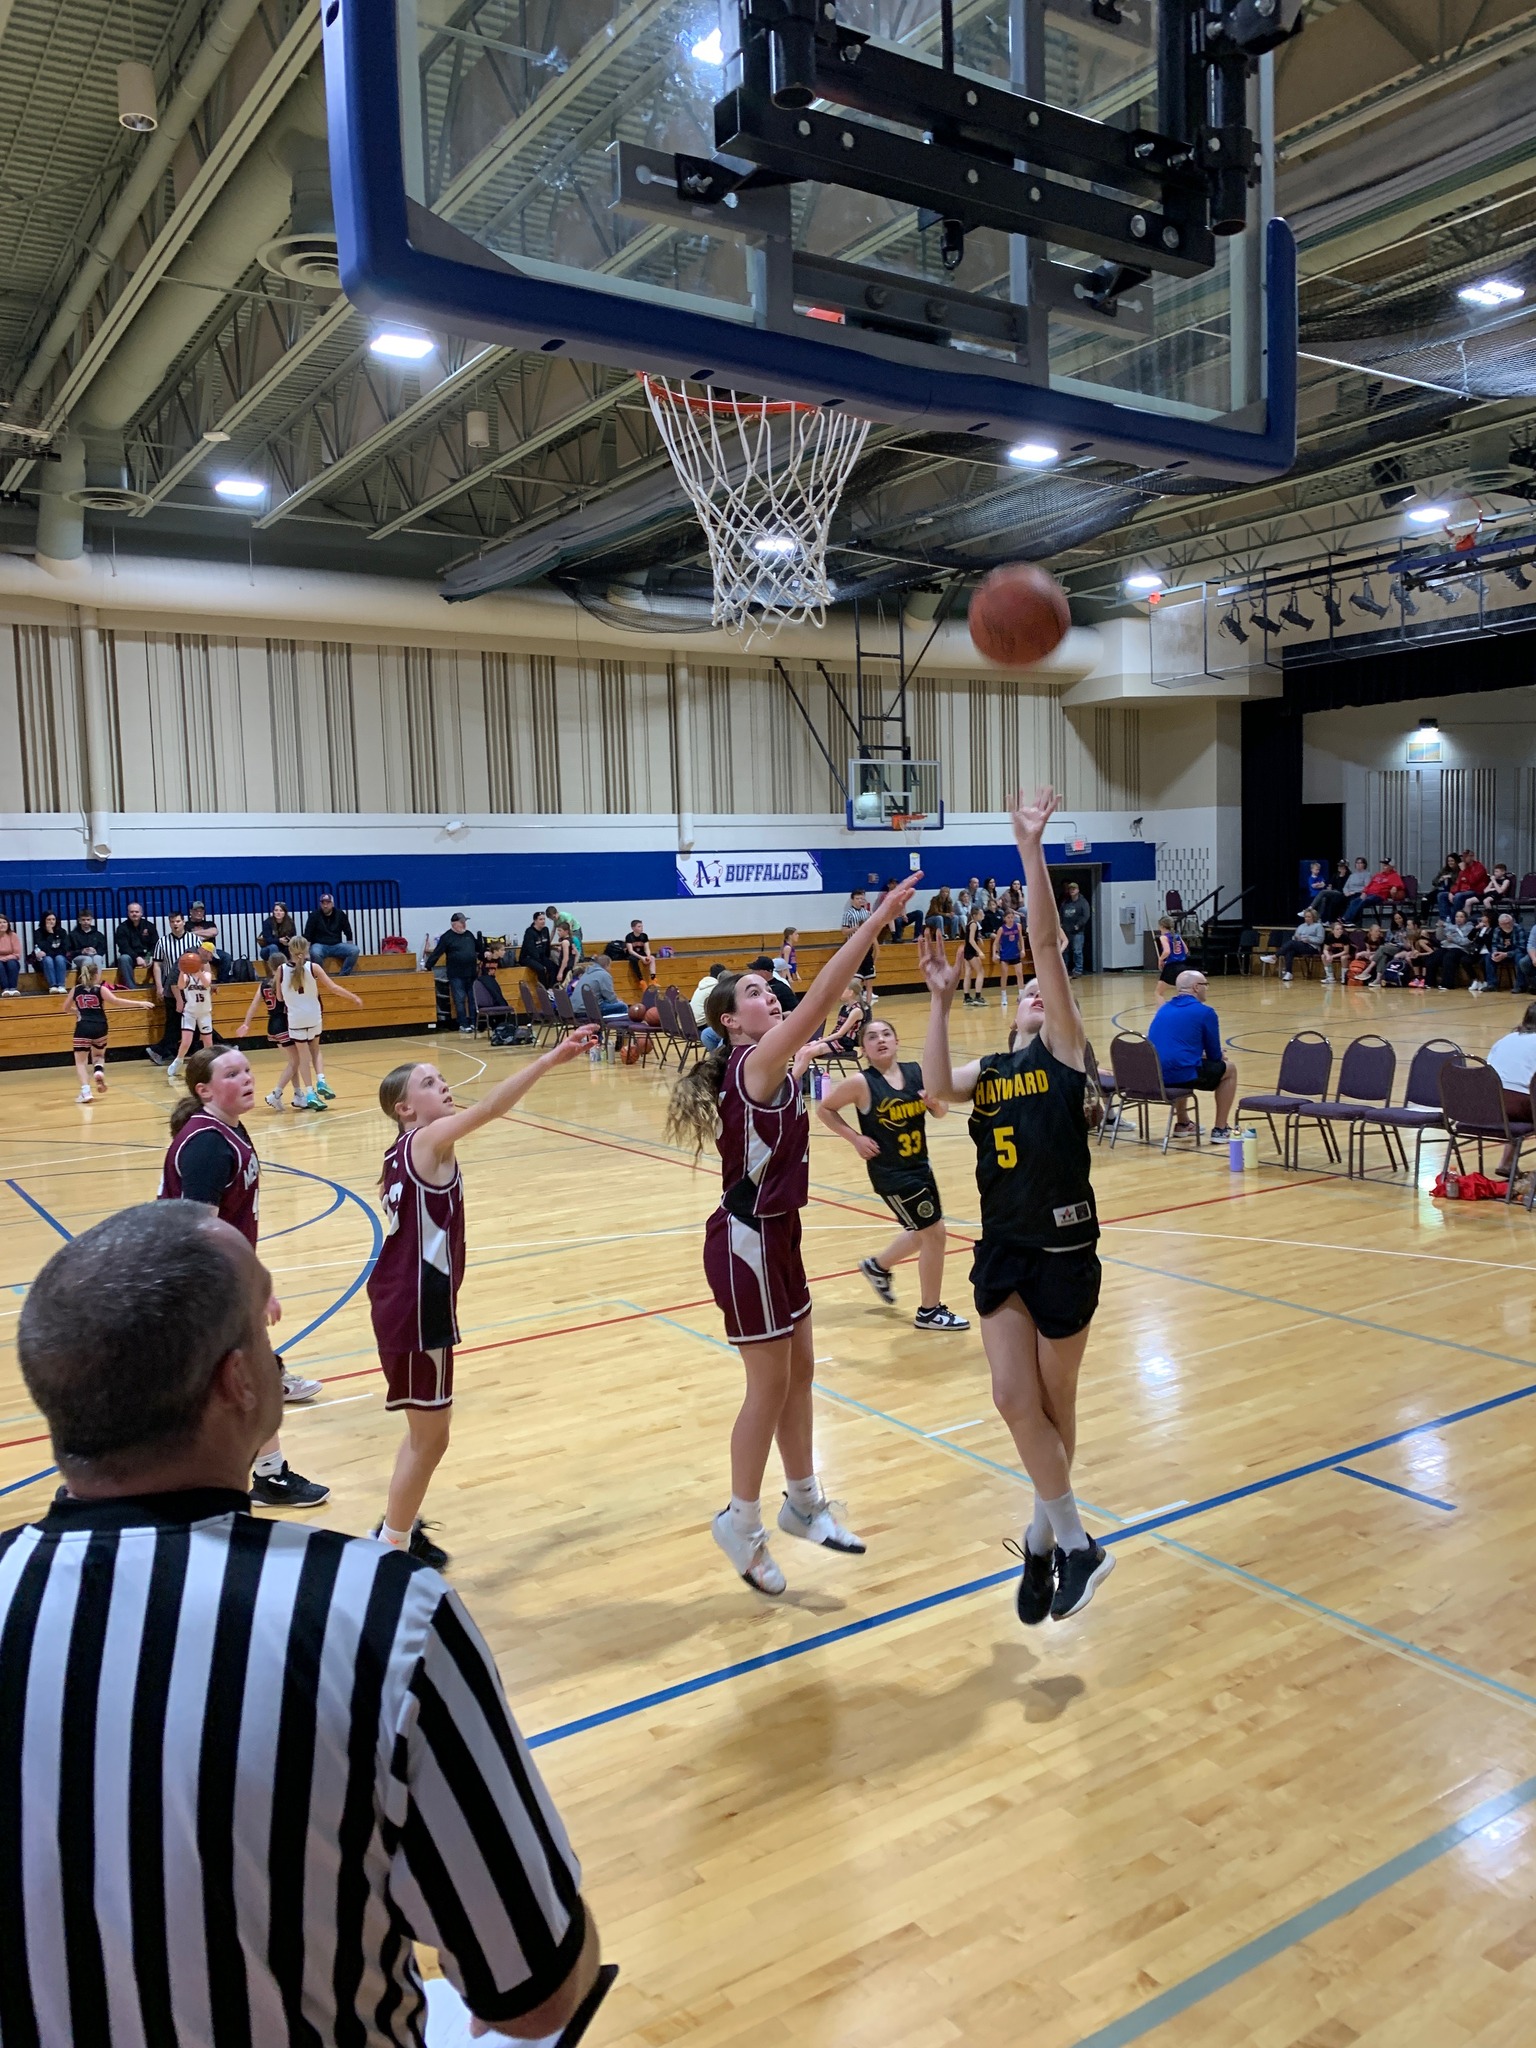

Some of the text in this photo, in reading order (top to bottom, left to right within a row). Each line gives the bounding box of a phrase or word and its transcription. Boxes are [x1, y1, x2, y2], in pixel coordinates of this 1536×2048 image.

[725, 862, 810, 883] BUFFALOES
[75, 994, 101, 1009] 12
[195, 993, 205, 1003] 15
[263, 988, 277, 1010] 5
[975, 1069, 1049, 1106] HAYWARD
[889, 1099, 927, 1121] HAYWAR
[897, 1129, 922, 1157] 33
[993, 1126, 1018, 1169] 5
